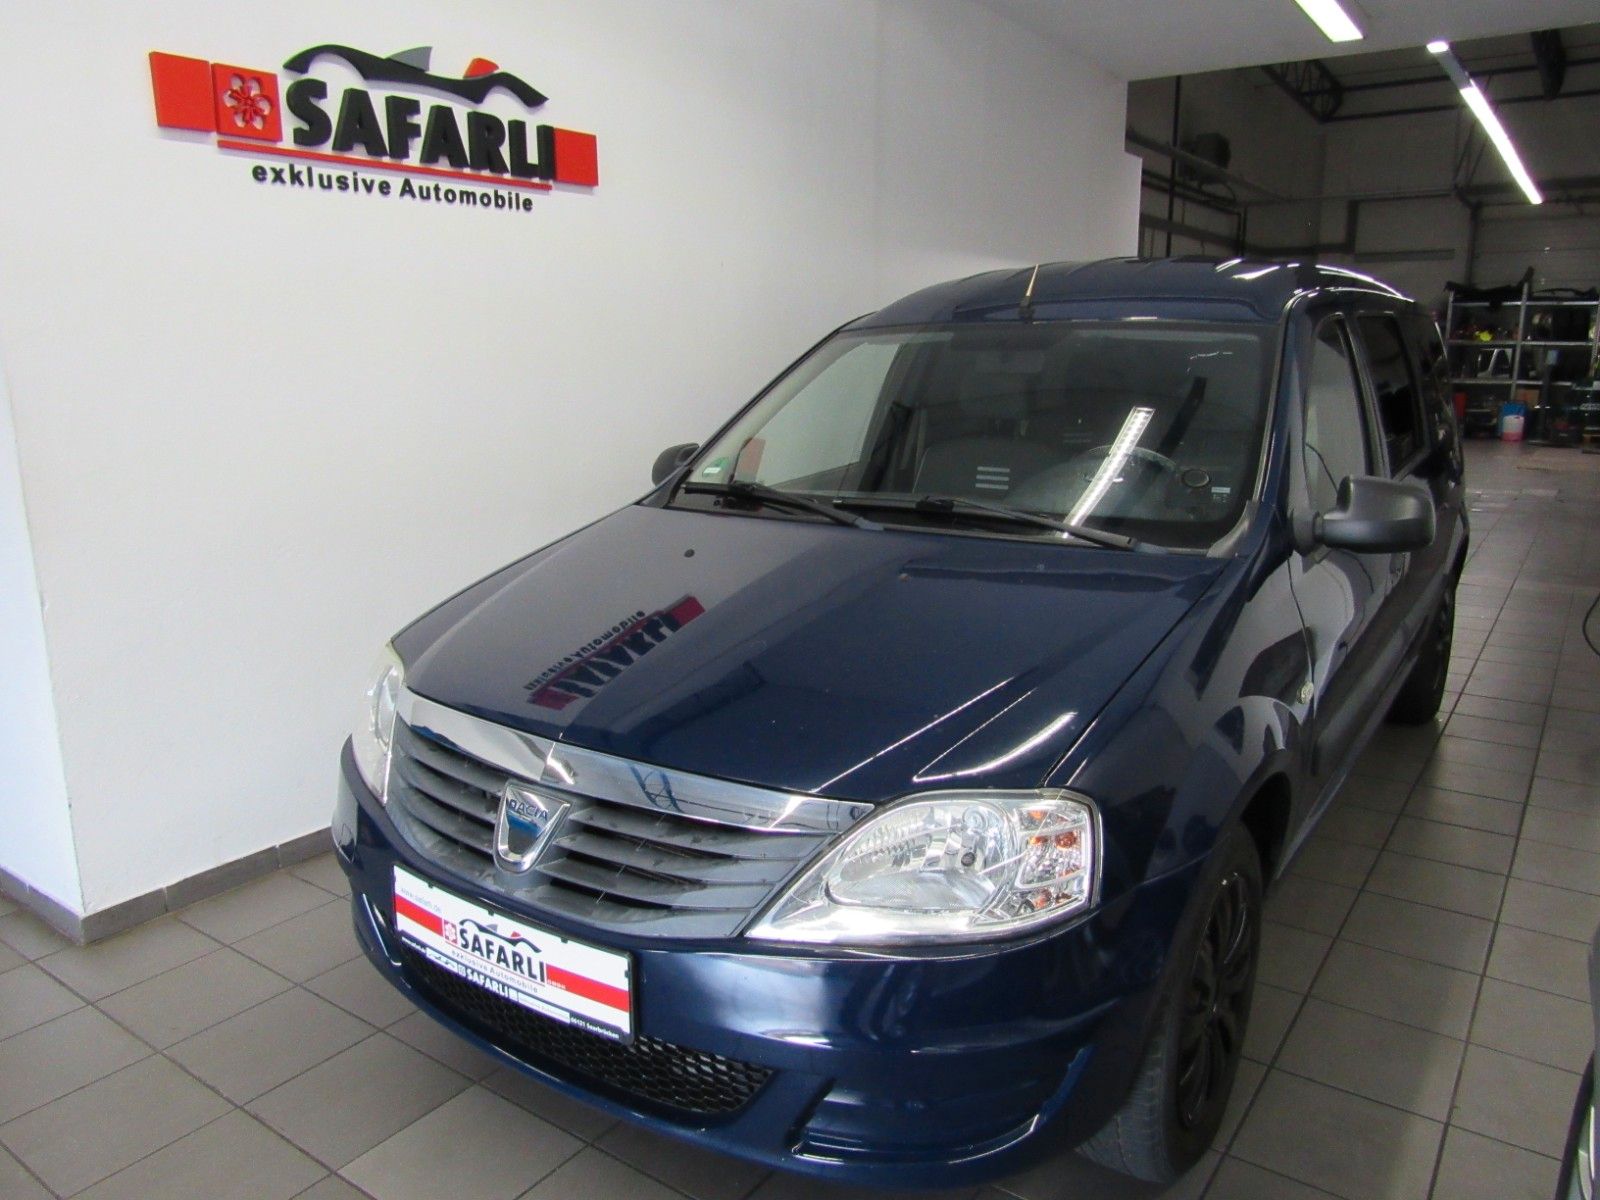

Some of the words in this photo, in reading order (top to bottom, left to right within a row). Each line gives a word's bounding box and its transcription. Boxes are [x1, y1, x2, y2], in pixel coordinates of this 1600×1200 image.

[285, 77, 555, 181] SAFARLI
[252, 161, 391, 197] exklusive
[399, 177, 534, 212] Automobile
[508, 798, 549, 821] DACIA
[459, 928, 545, 983] SAFARLI
[466, 966, 510, 1000] SAFARLI
[489, 965, 538, 994] Automobile
